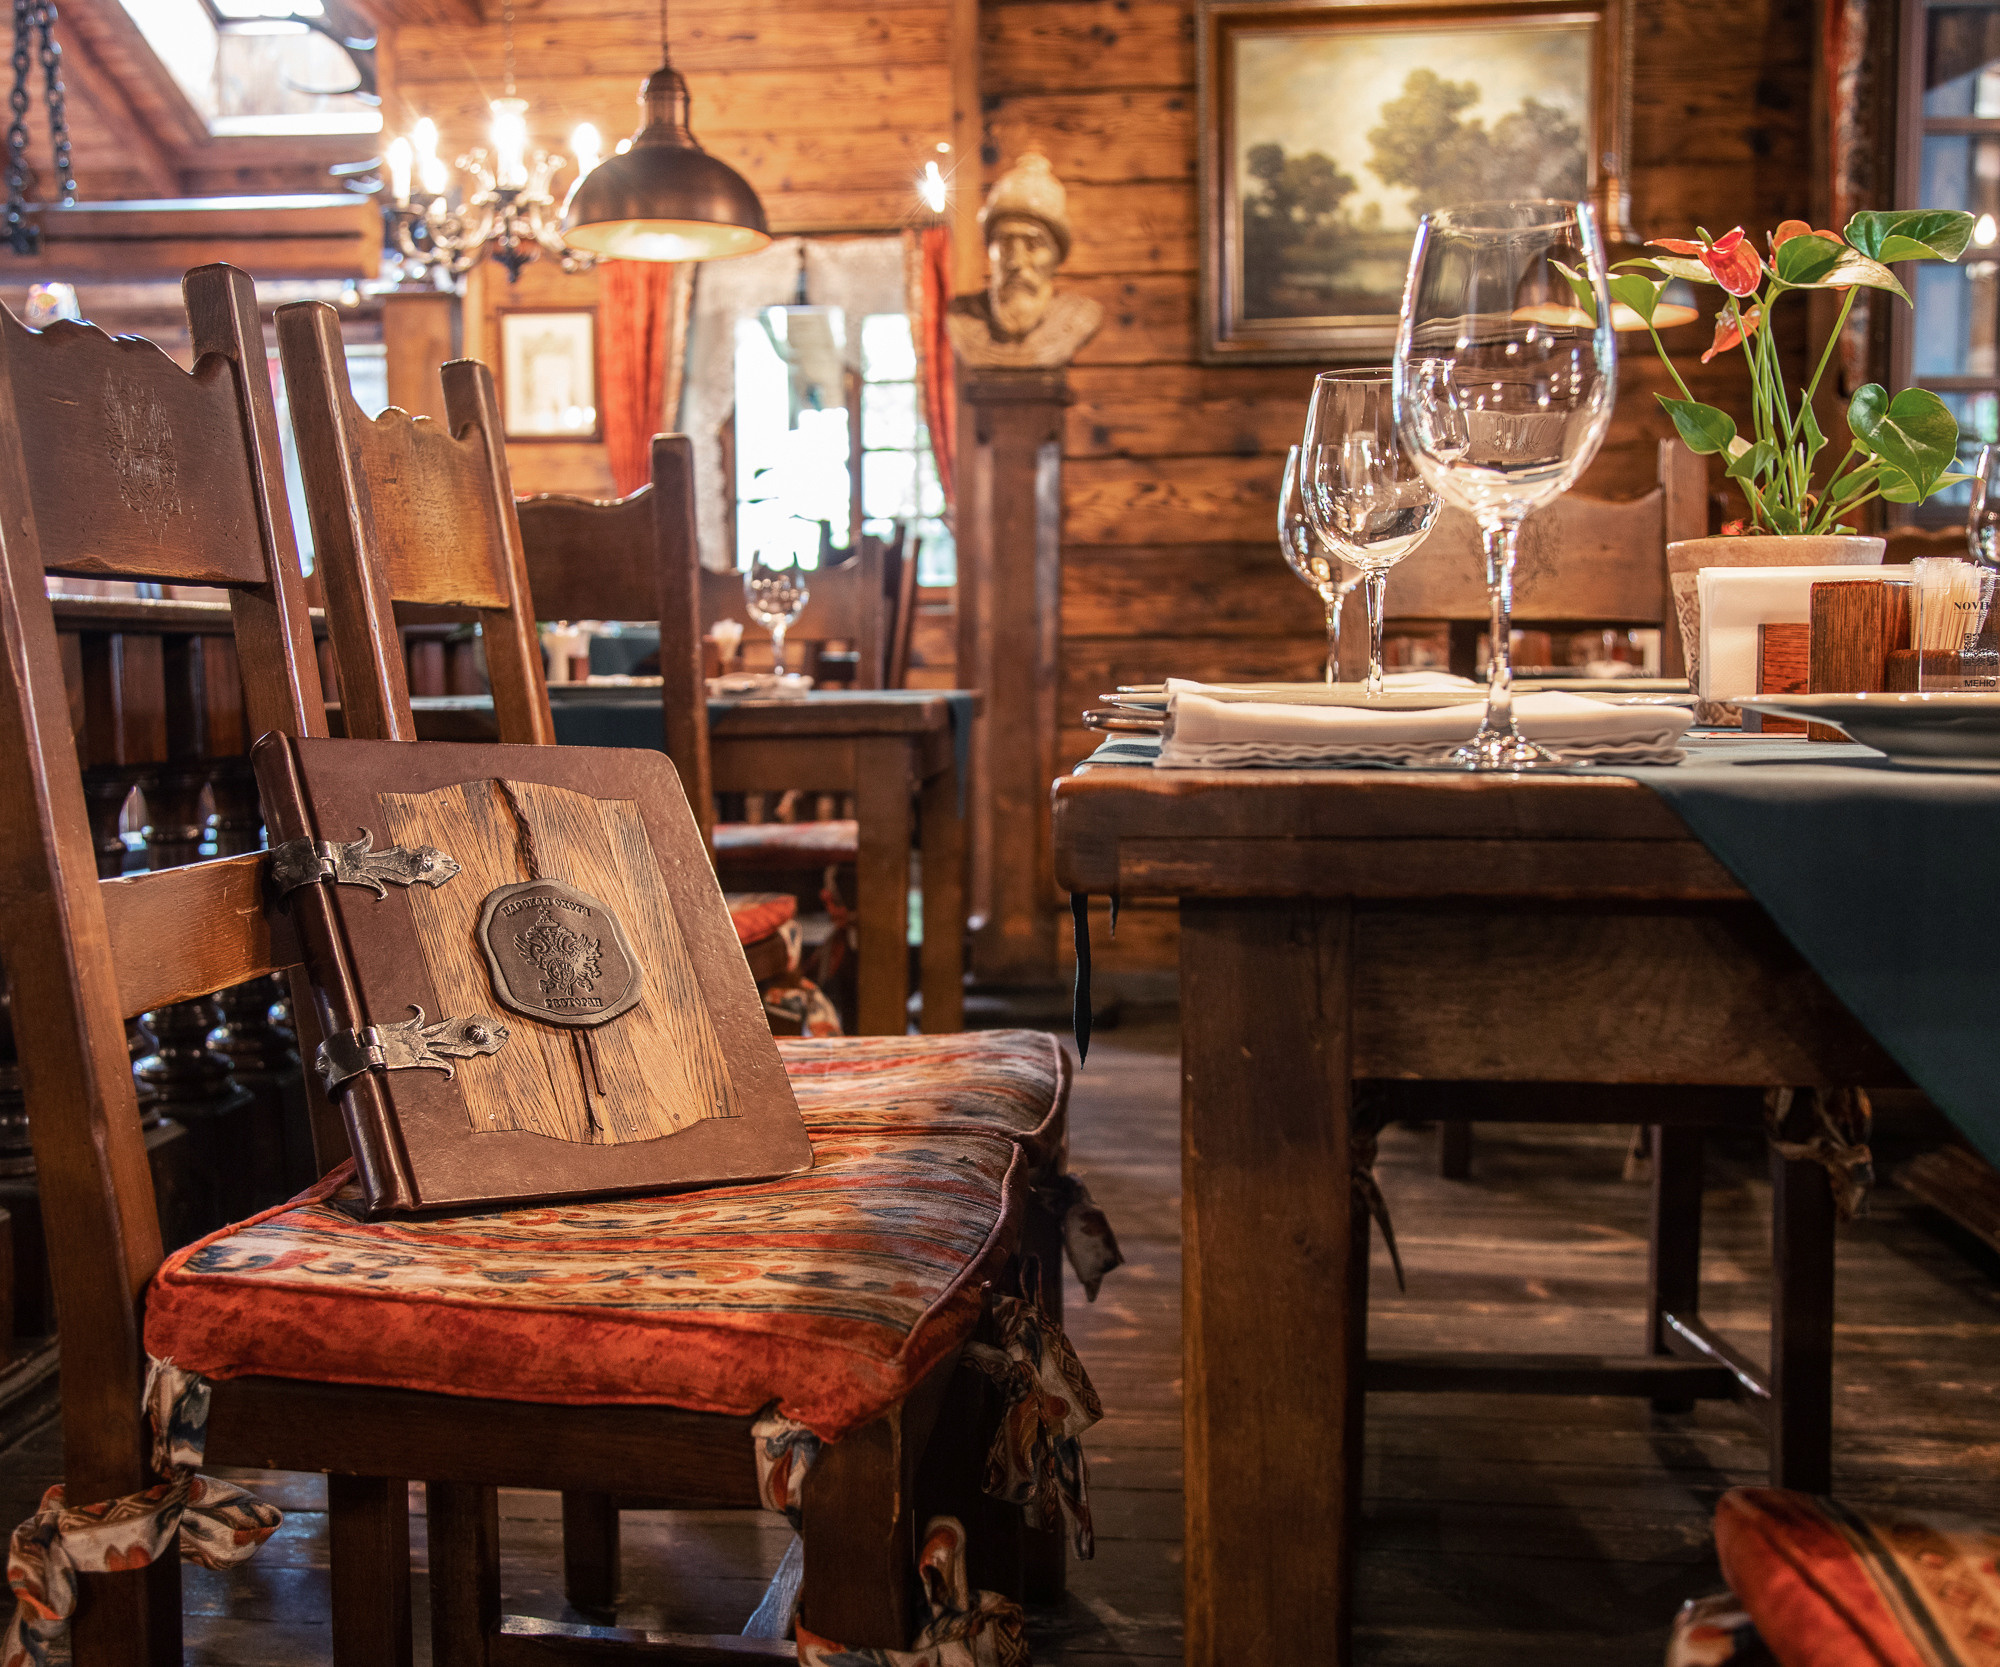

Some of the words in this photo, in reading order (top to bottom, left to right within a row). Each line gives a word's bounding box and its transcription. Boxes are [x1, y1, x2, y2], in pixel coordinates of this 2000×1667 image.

[1964, 679, 1996, 688] МЕНЮ
[500, 897, 552, 917] ЦАРСКАЯ
[552, 897, 592, 917] ОХОТА
[544, 997, 604, 1008] РЕСТОРАН
